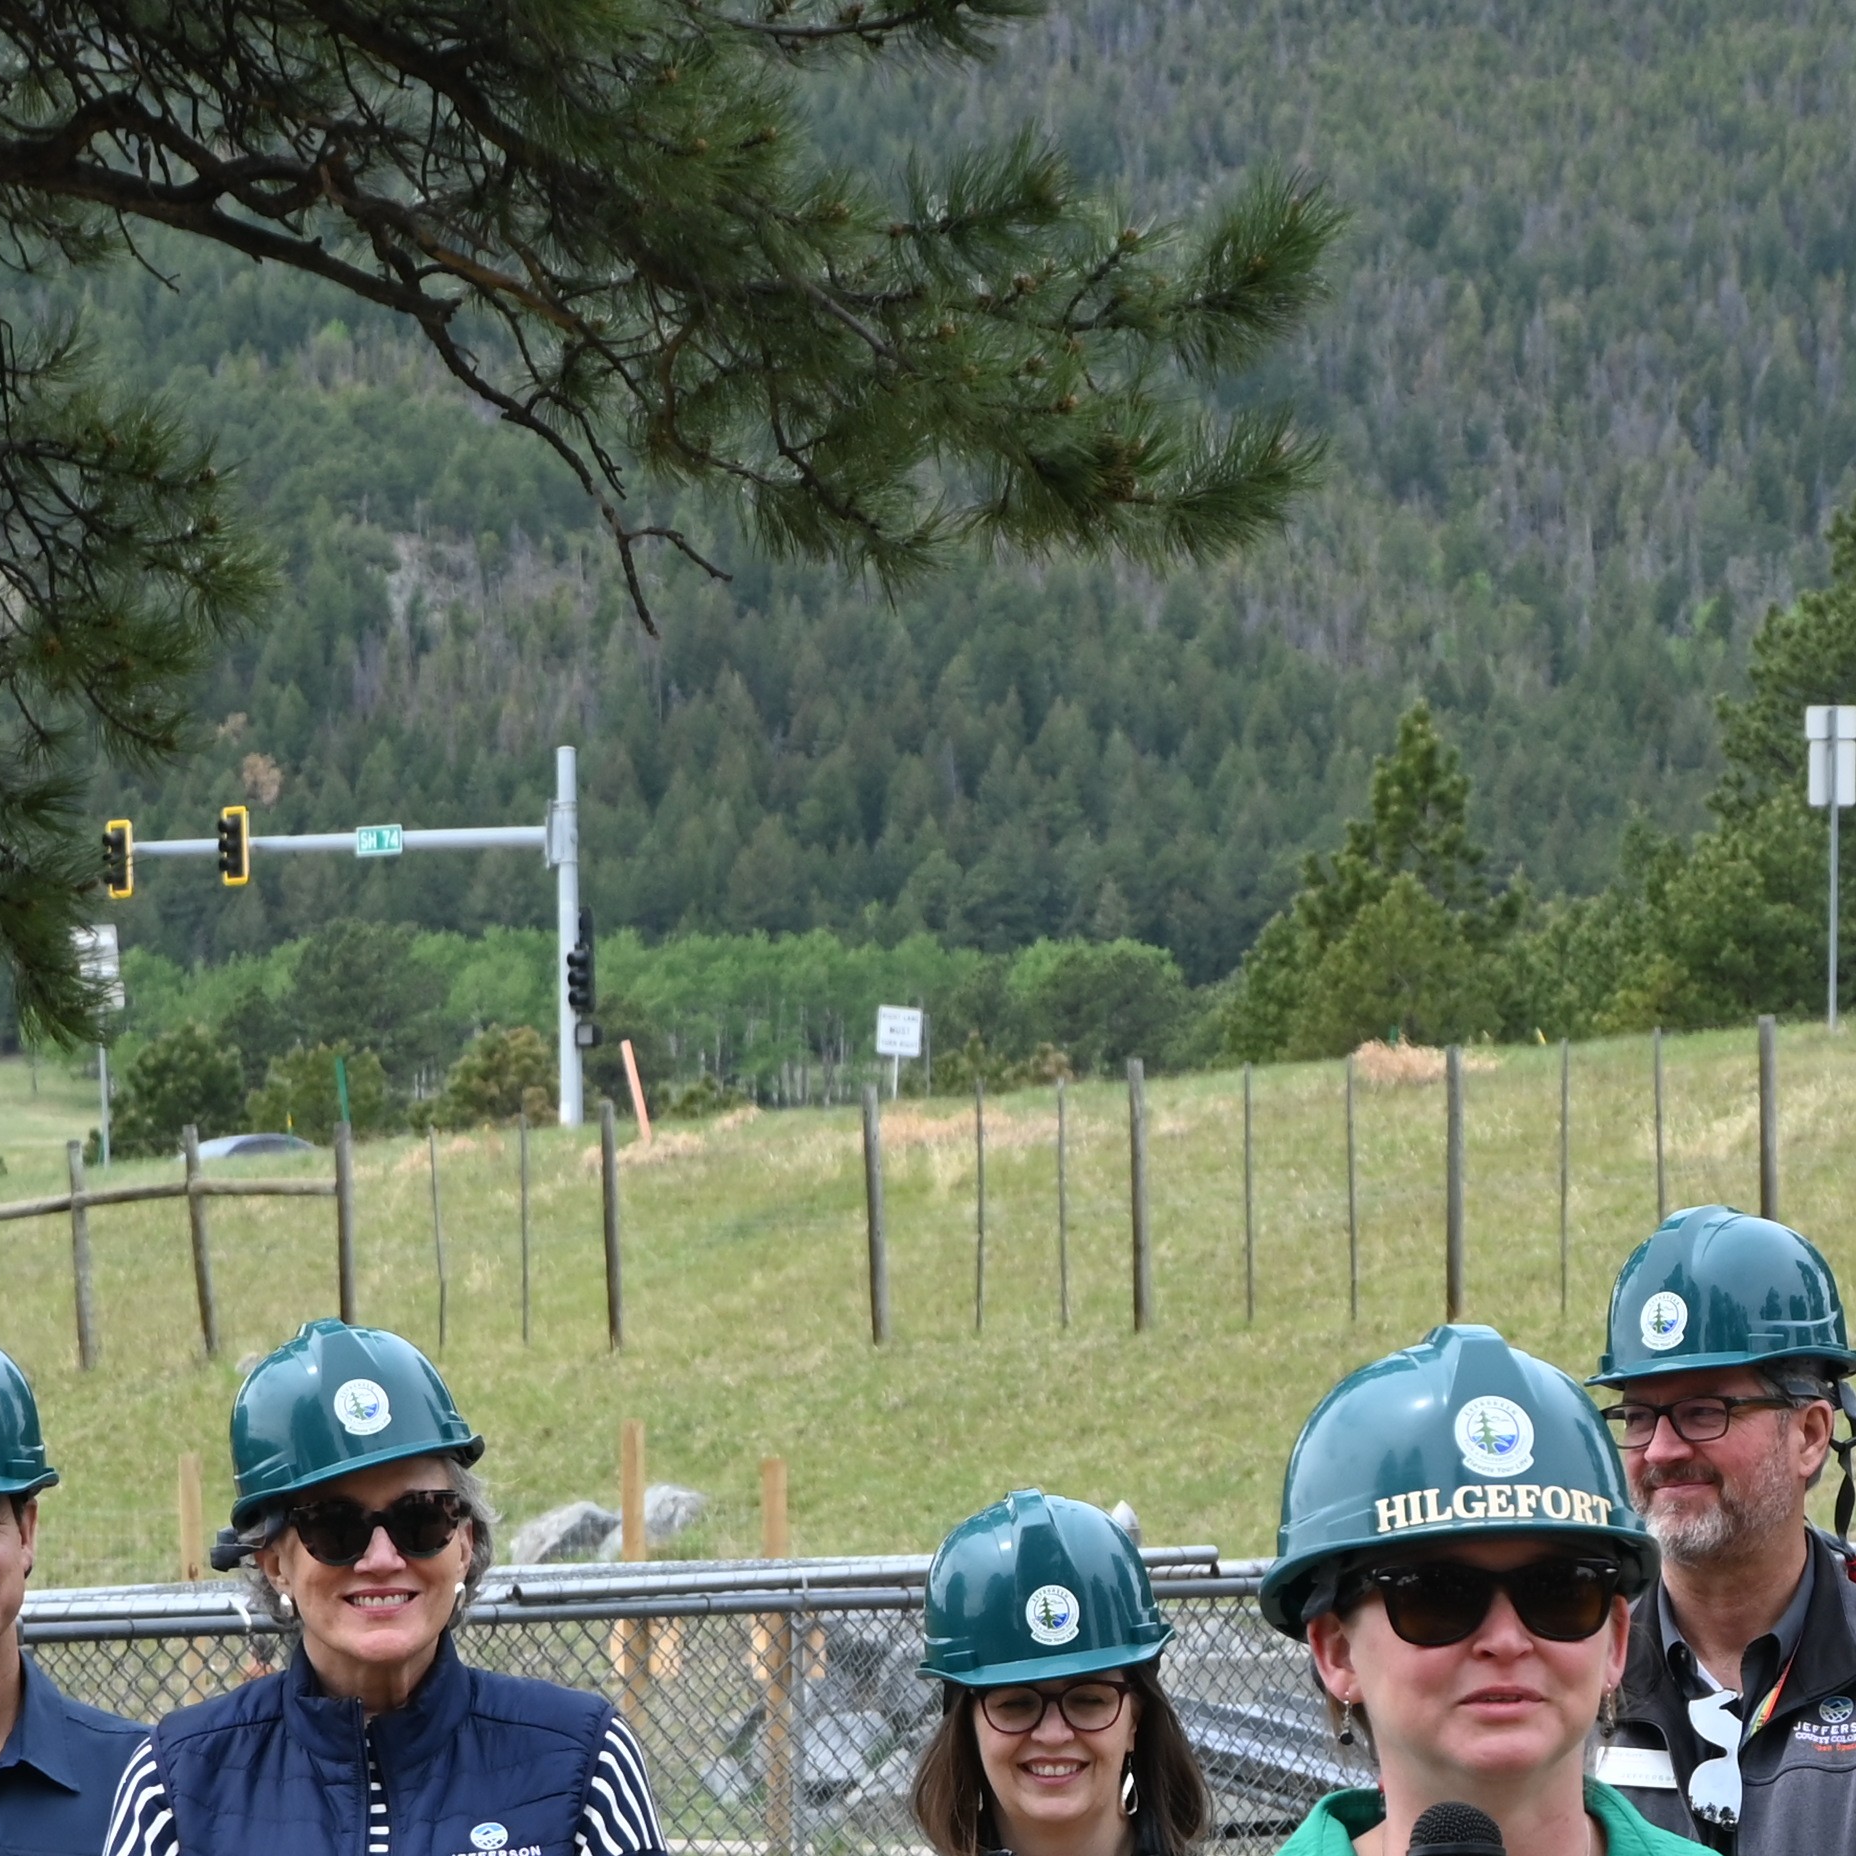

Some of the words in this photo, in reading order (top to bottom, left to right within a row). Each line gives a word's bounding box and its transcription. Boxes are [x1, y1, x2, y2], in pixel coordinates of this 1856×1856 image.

[361, 831, 377, 849] SH
[382, 829, 399, 847] 74
[1375, 1485, 1612, 1532] HILGEFORT
